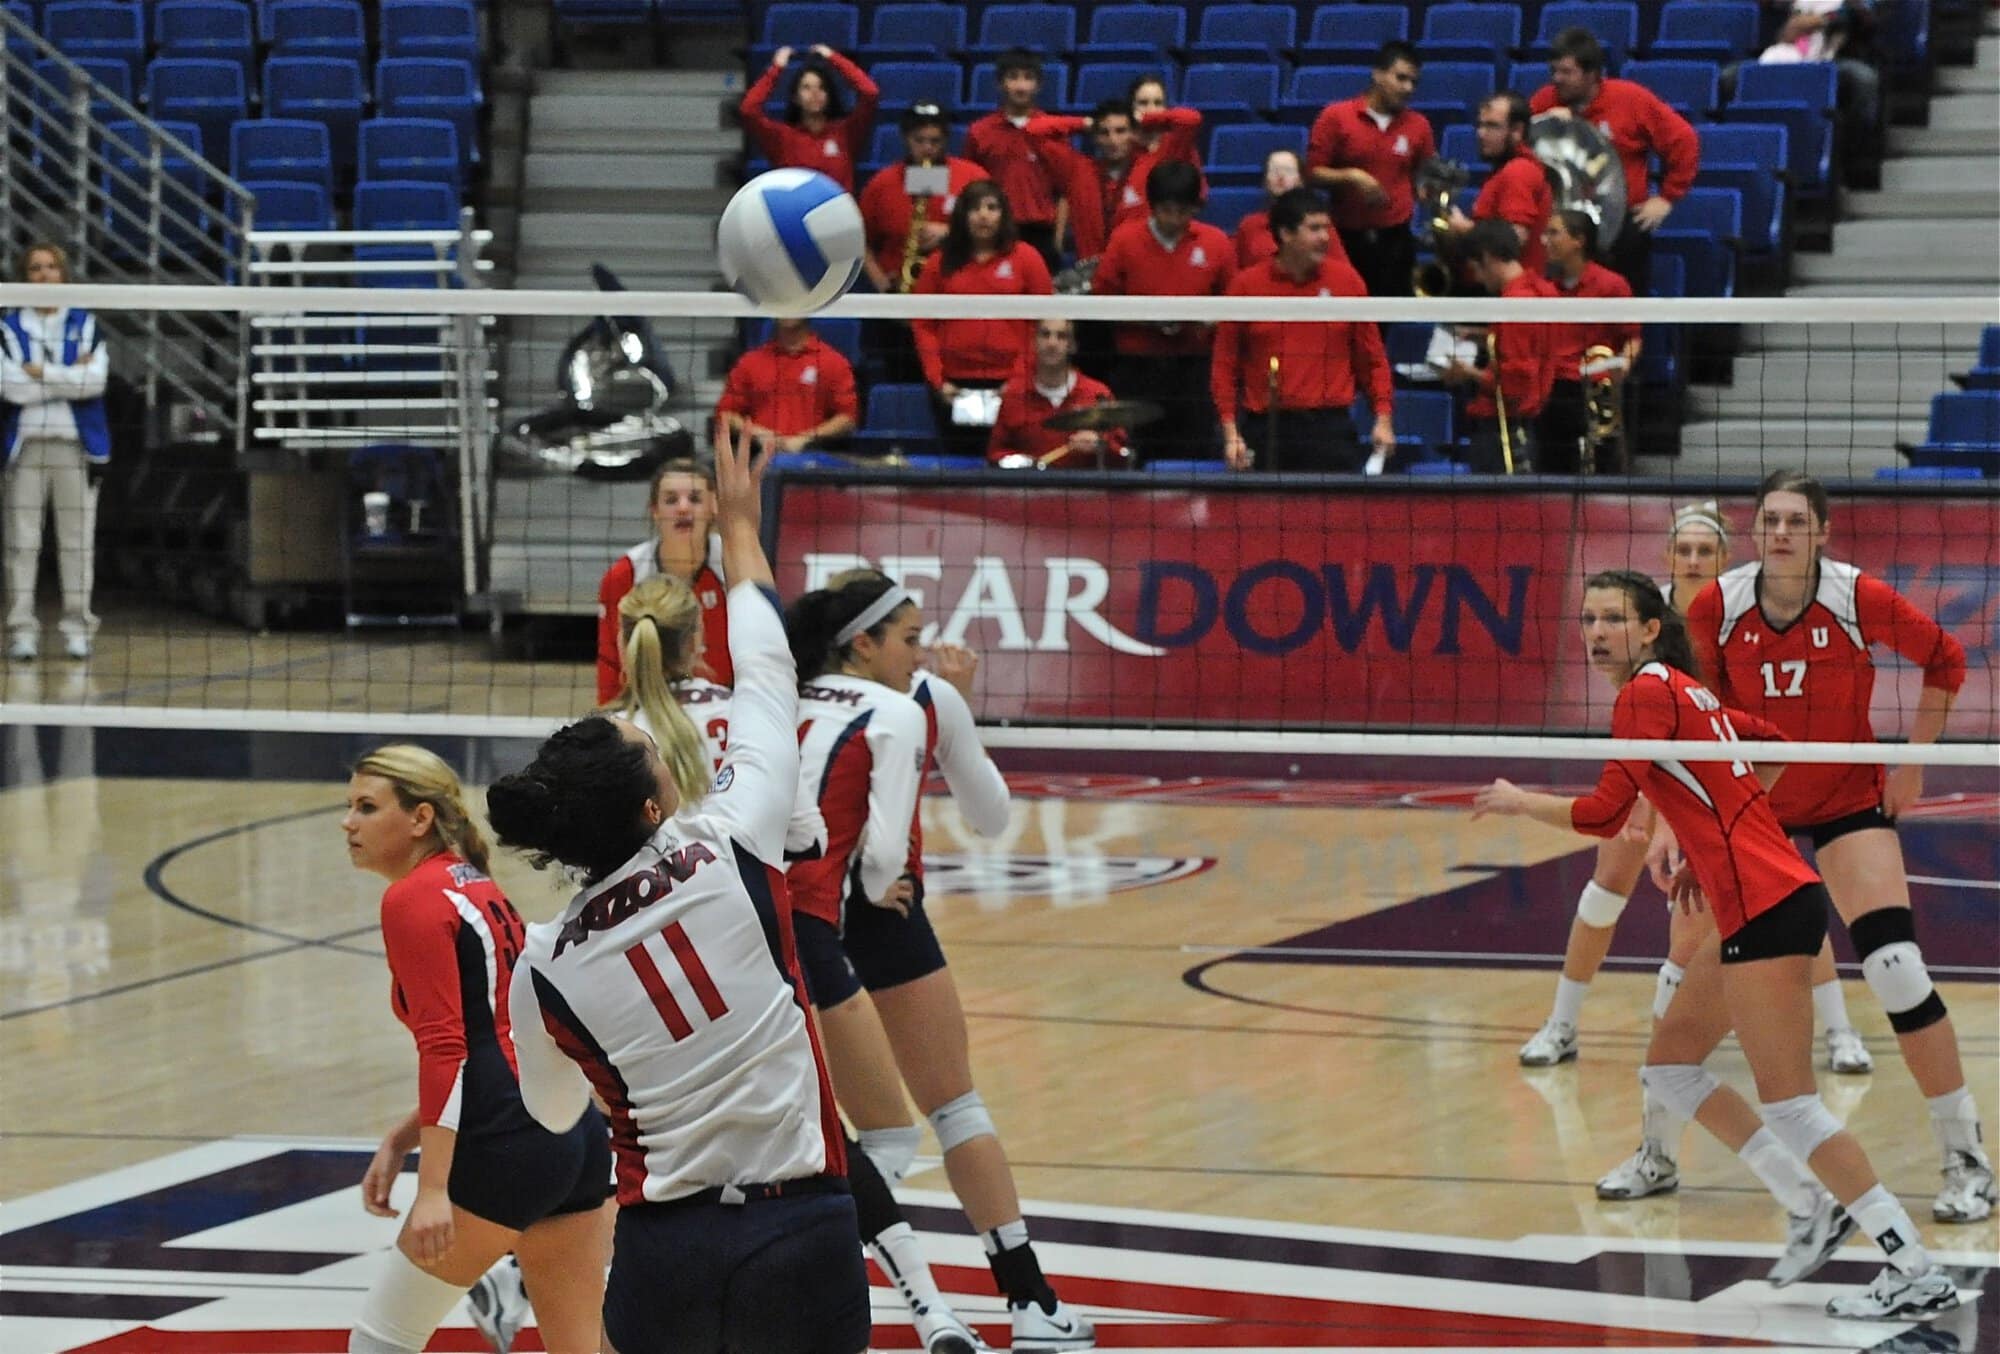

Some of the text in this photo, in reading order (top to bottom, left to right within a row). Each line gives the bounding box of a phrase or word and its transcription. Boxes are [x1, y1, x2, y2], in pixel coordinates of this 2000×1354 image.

[1136, 559, 1534, 657] DOWN
[1811, 626, 1829, 648] U
[1760, 659, 1807, 696] 17
[551, 841, 717, 962] ARIZONA
[624, 919, 729, 1042] 11
